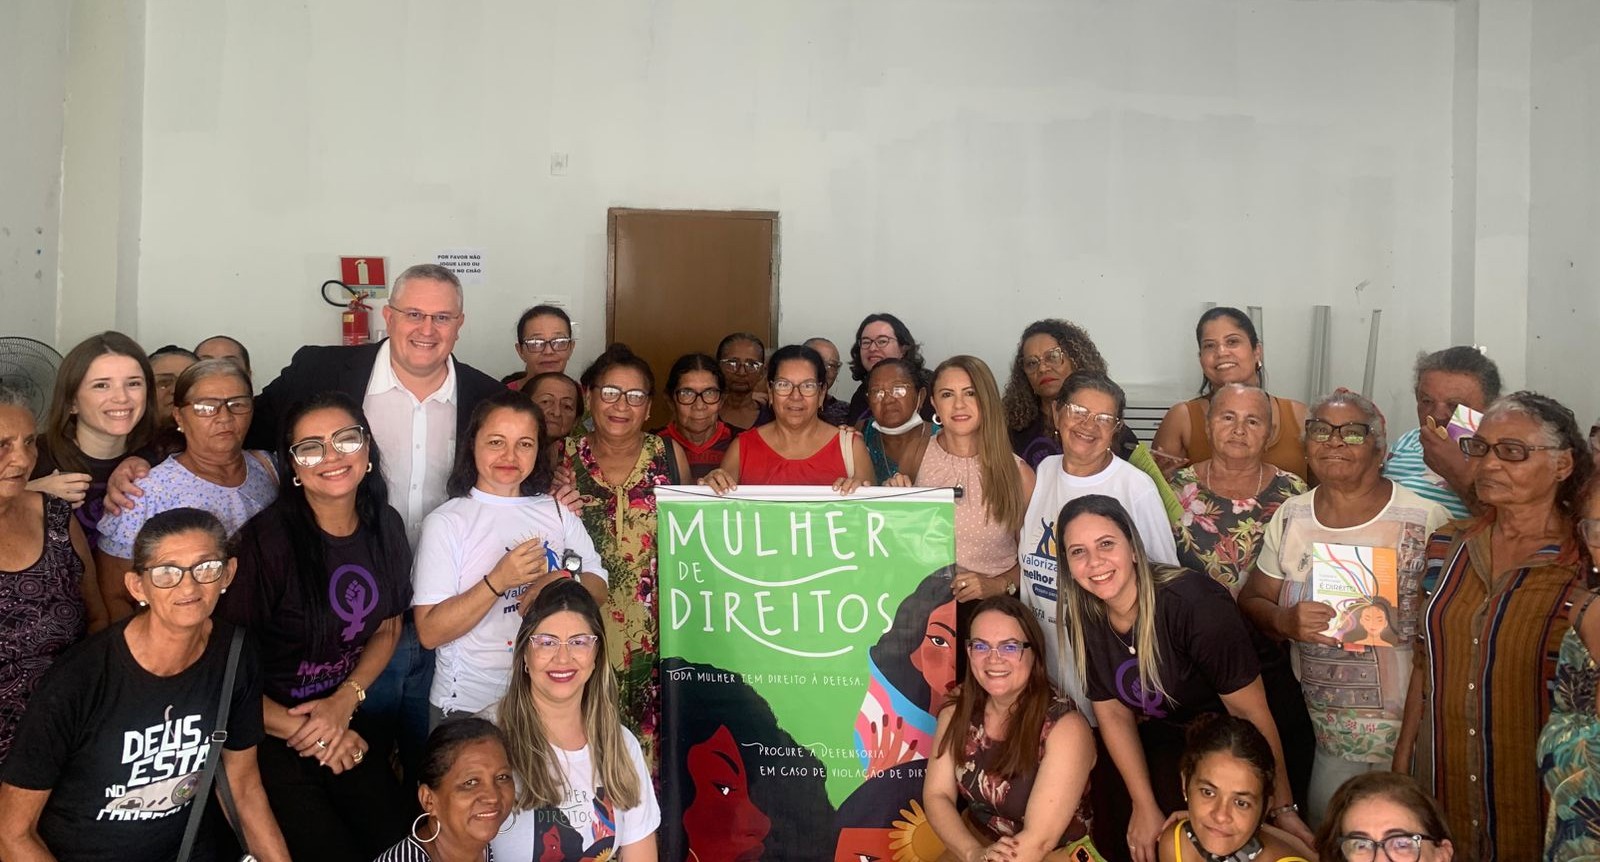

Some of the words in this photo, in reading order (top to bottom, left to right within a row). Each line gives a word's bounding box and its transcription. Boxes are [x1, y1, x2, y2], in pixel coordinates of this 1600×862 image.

[668, 509, 889, 587] MULHER
[678, 561, 704, 583] DE
[1023, 569, 1054, 585] melhor
[503, 602, 521, 614] me
[671, 588, 893, 657] DIREITOS
[666, 667, 696, 681] TODA
[696, 672, 736, 684] MULHER
[741, 673, 763, 684] TEM
[768, 673, 807, 685] DIREITO
[811, 672, 818, 685] À
[823, 675, 864, 687] DEFESA.
[121, 714, 202, 764] DEUS
[801, 742, 885, 759] DEFENSORIA
[809, 748, 817, 757] A
[760, 766, 776, 777] EM
[780, 766, 808, 777] CASO
[813, 767, 826, 778] DE
[831, 767, 885, 781] VIOLAÇÃO
[889, 769, 903, 779] DE
[909, 768, 928, 779] DIR
[105, 784, 126, 798] NO
[538, 810, 593, 829] DIREITOS
